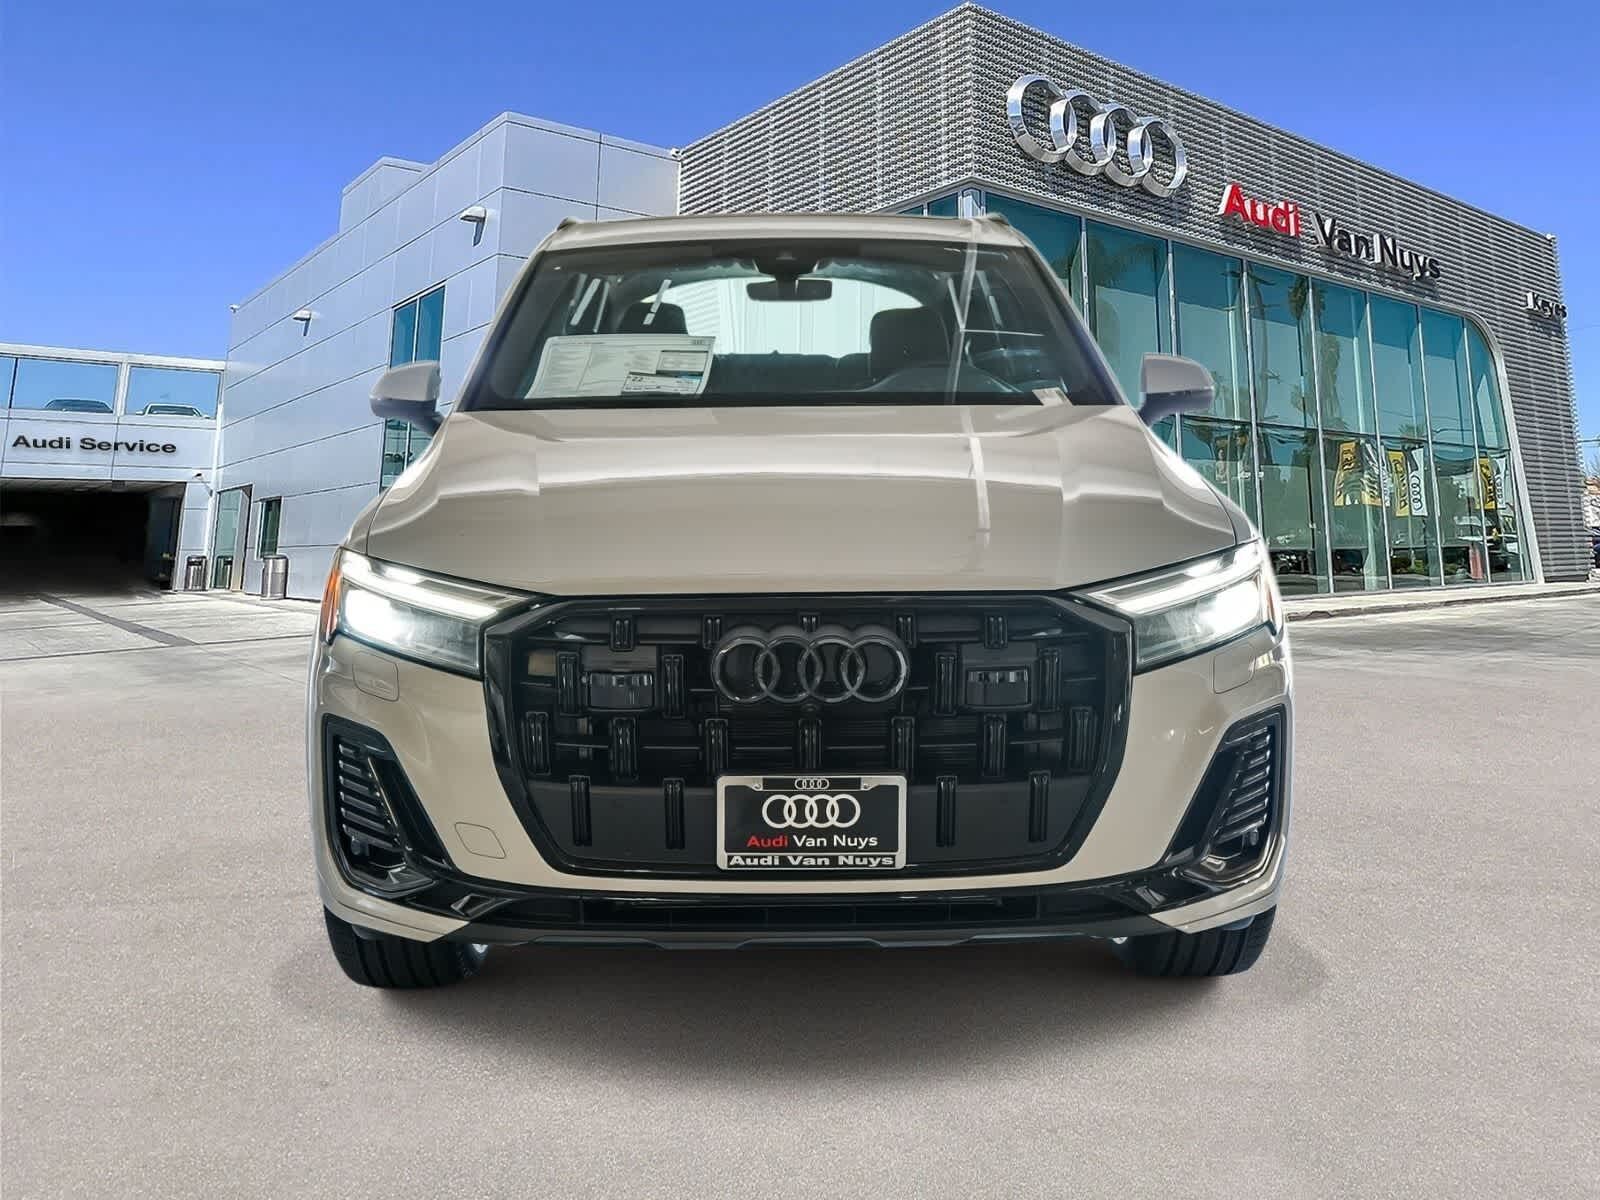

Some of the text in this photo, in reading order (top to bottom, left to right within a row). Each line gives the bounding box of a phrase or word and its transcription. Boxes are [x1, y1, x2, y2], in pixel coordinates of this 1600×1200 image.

[1217, 183, 1441, 280] Audi Van Nuys
[1527, 291, 1568, 319] Keyes
[12, 434, 177, 454] Audi Service
[747, 834, 878, 849] Audi Van Nuys
[729, 855, 895, 867] Audi Van Nuys
